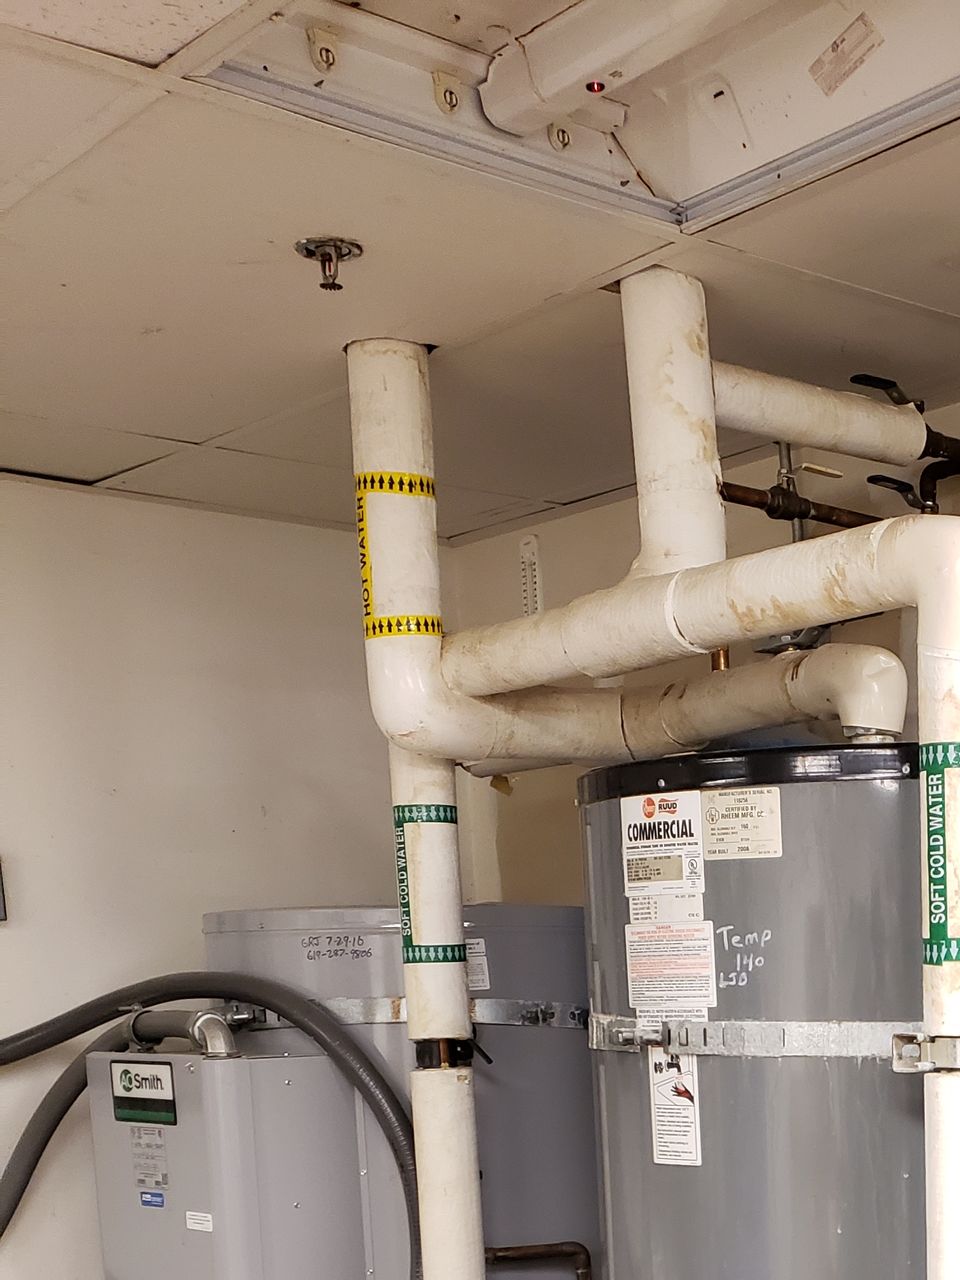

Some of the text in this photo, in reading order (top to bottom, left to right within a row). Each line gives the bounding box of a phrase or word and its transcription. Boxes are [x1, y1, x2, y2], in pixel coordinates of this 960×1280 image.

[357, 496, 371, 617] HOT WATER
[658, 802, 678, 810] RUUD
[627, 819, 694, 841] COMMERCIAL
[929, 773, 945, 923] SOFT COLD WATER
[395, 826, 411, 936] SOFT COLD WATER
[716, 925, 771, 950] Temp
[737, 953, 764, 971] 140
[134, 1073, 162, 1090] Smith
